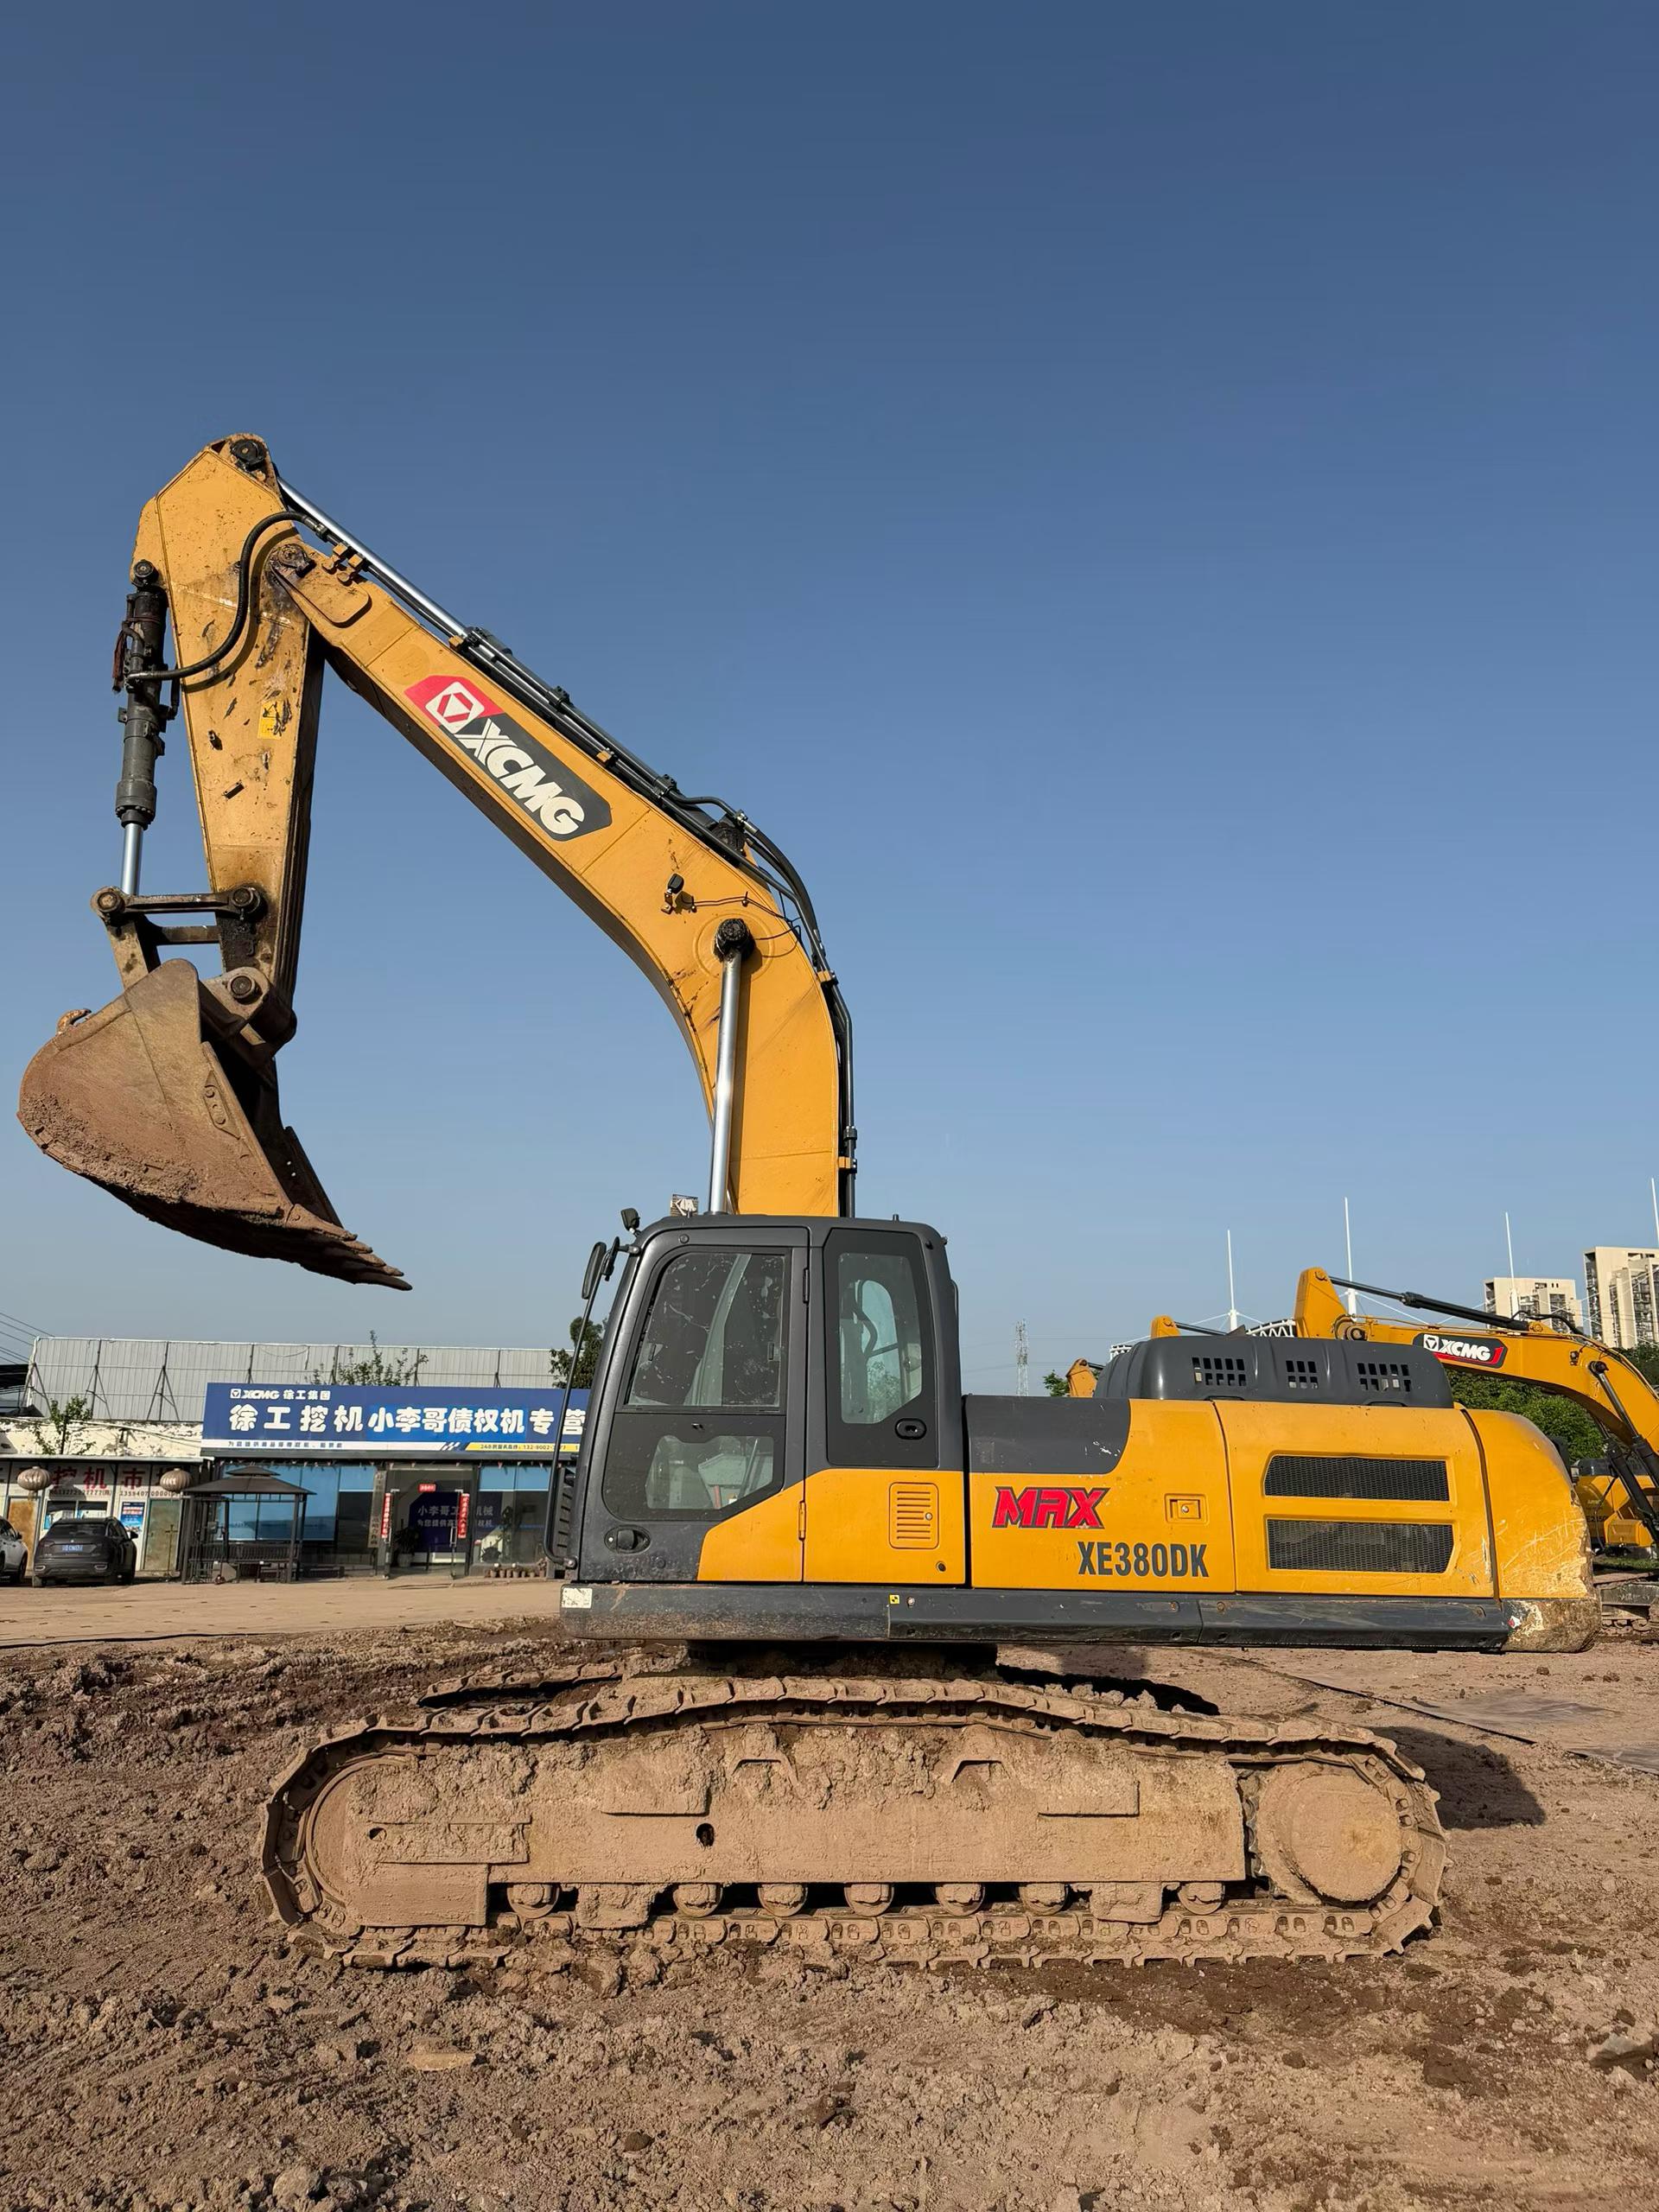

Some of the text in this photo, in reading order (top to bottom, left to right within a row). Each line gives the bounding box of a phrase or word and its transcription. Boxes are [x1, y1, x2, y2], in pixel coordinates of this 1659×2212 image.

[454, 718, 585, 835] XCMG
[1439, 1338, 1491, 1362] XCMG
[241, 1389, 331, 1401] XCMG 徐工集团
[992, 1486, 1110, 1529] MAX
[1077, 1541, 1209, 1578] XE380DK
